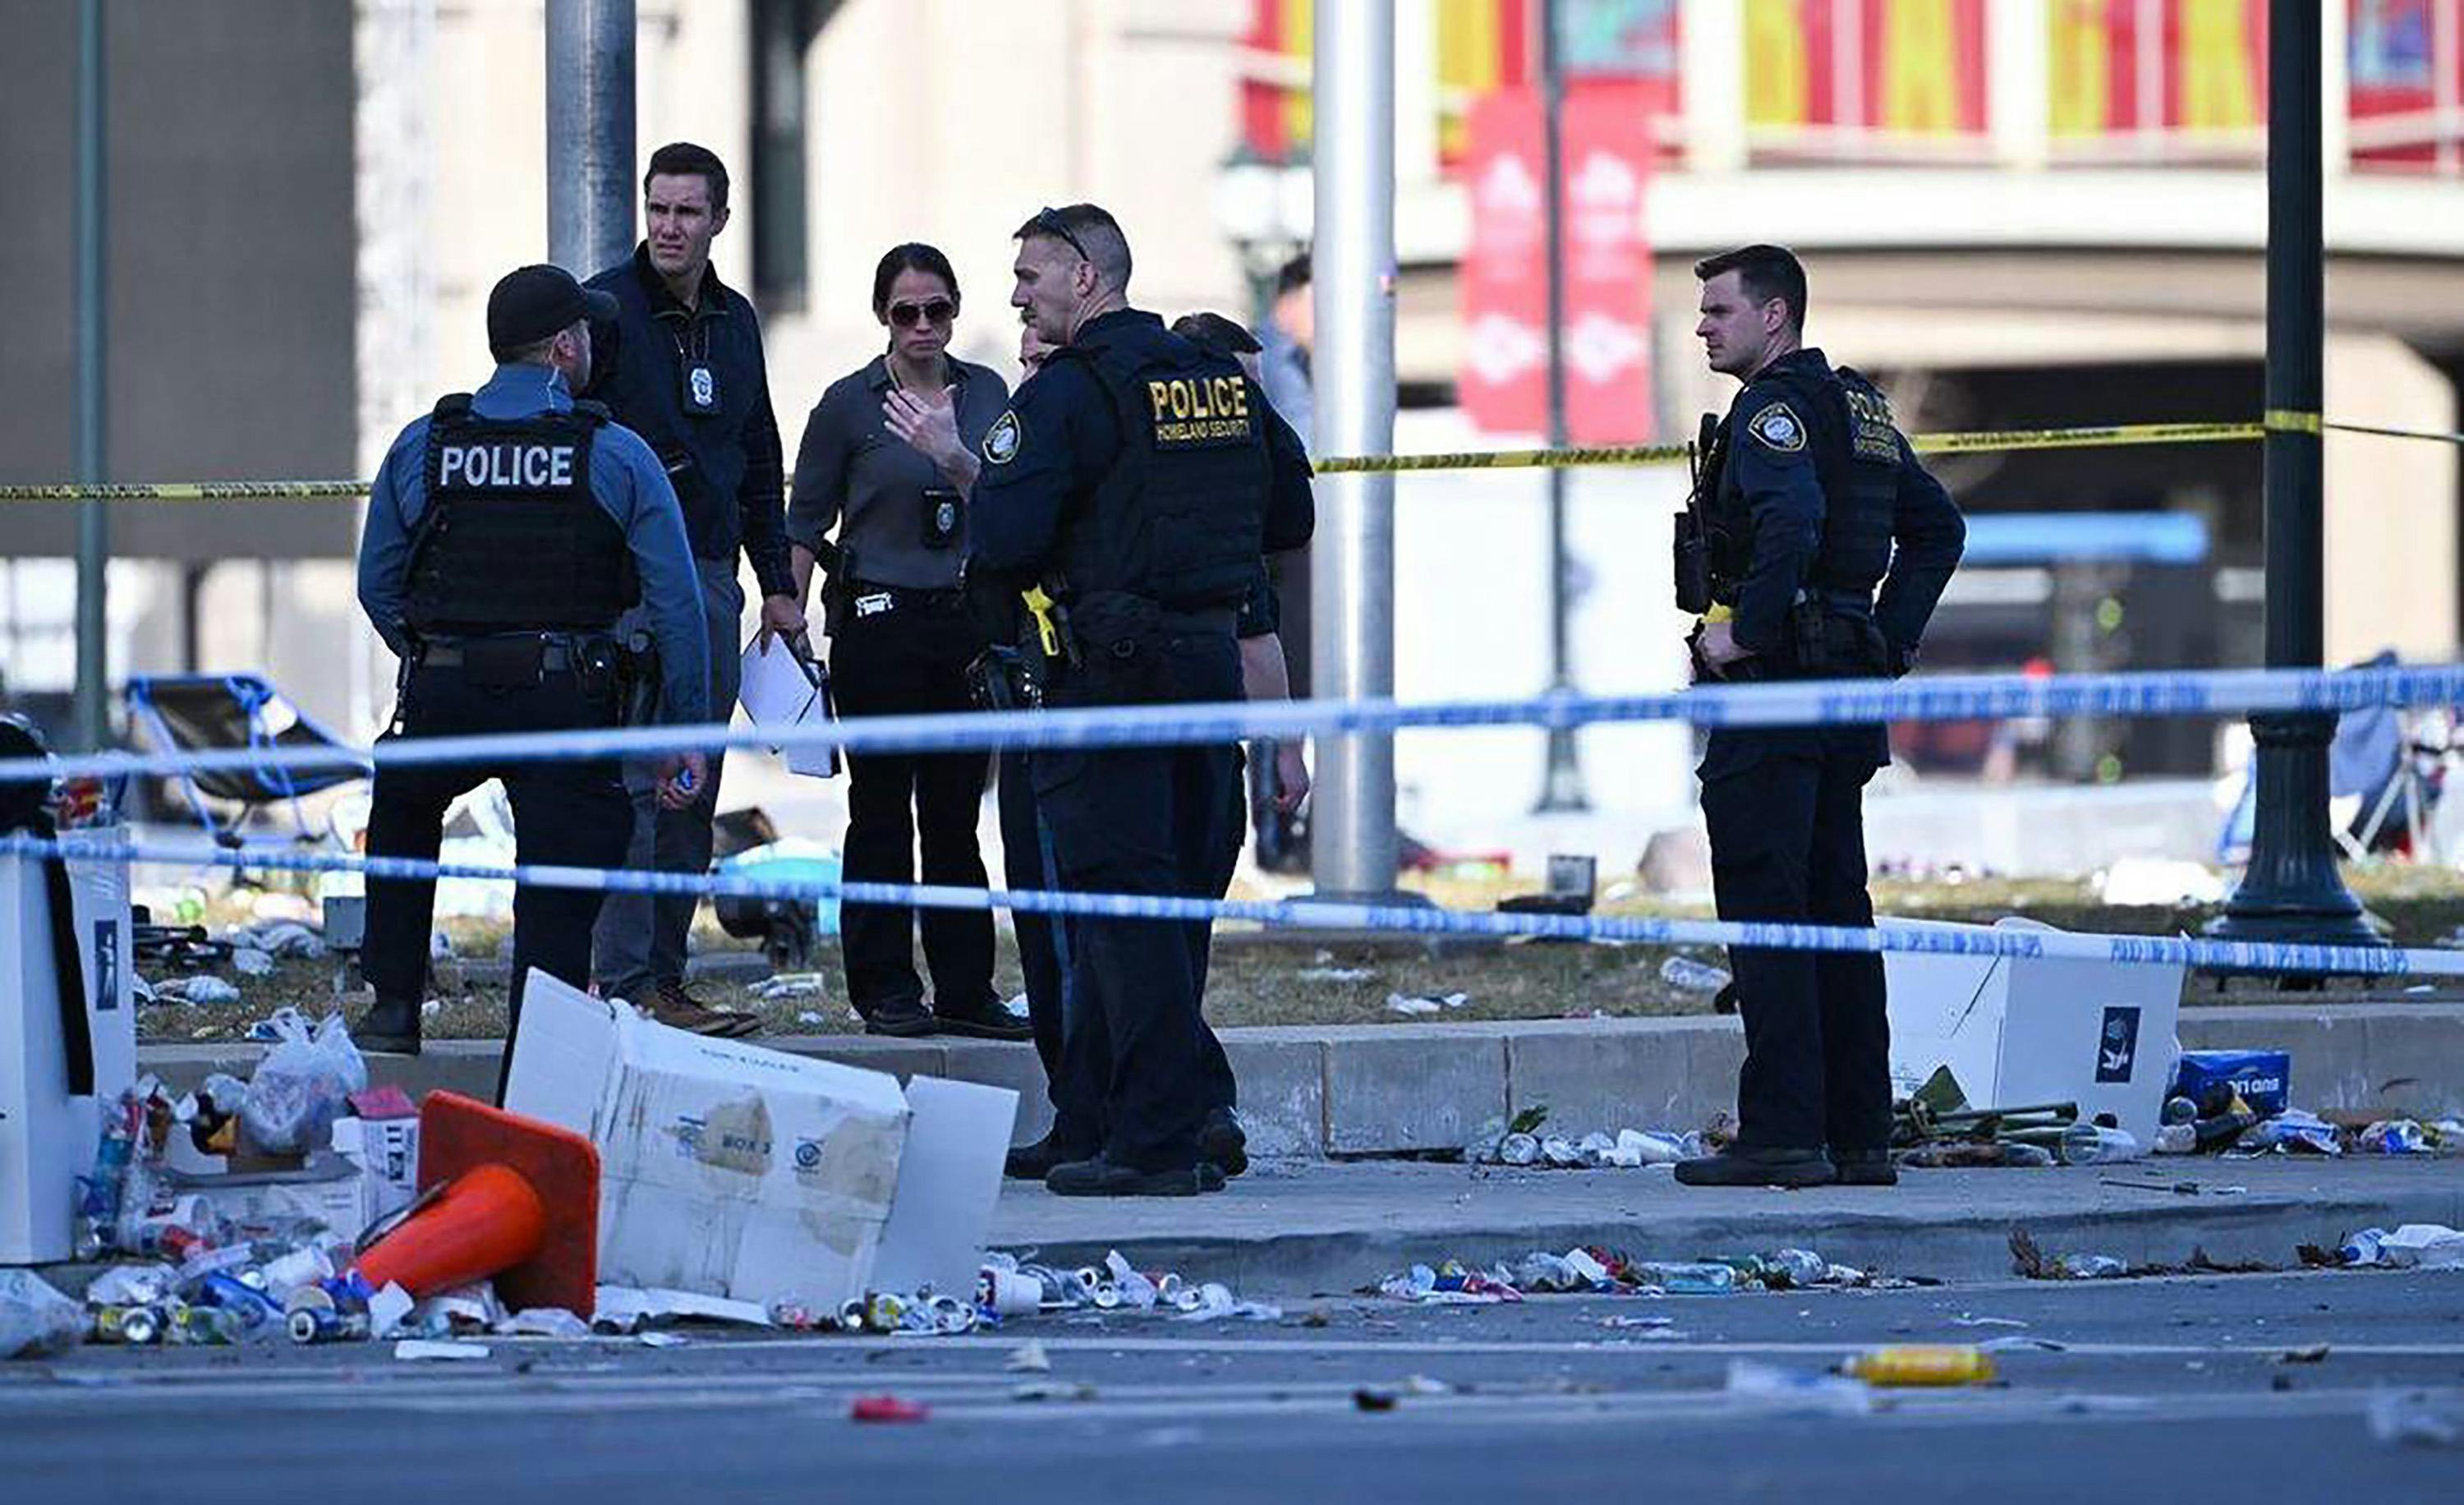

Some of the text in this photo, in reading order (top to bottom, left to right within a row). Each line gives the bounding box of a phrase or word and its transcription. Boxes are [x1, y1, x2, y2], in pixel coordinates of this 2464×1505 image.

[1149, 375, 1248, 421] POLICE
[1156, 419, 1250, 441] HOMELAND SECURITY
[440, 445, 574, 486] POLICE
